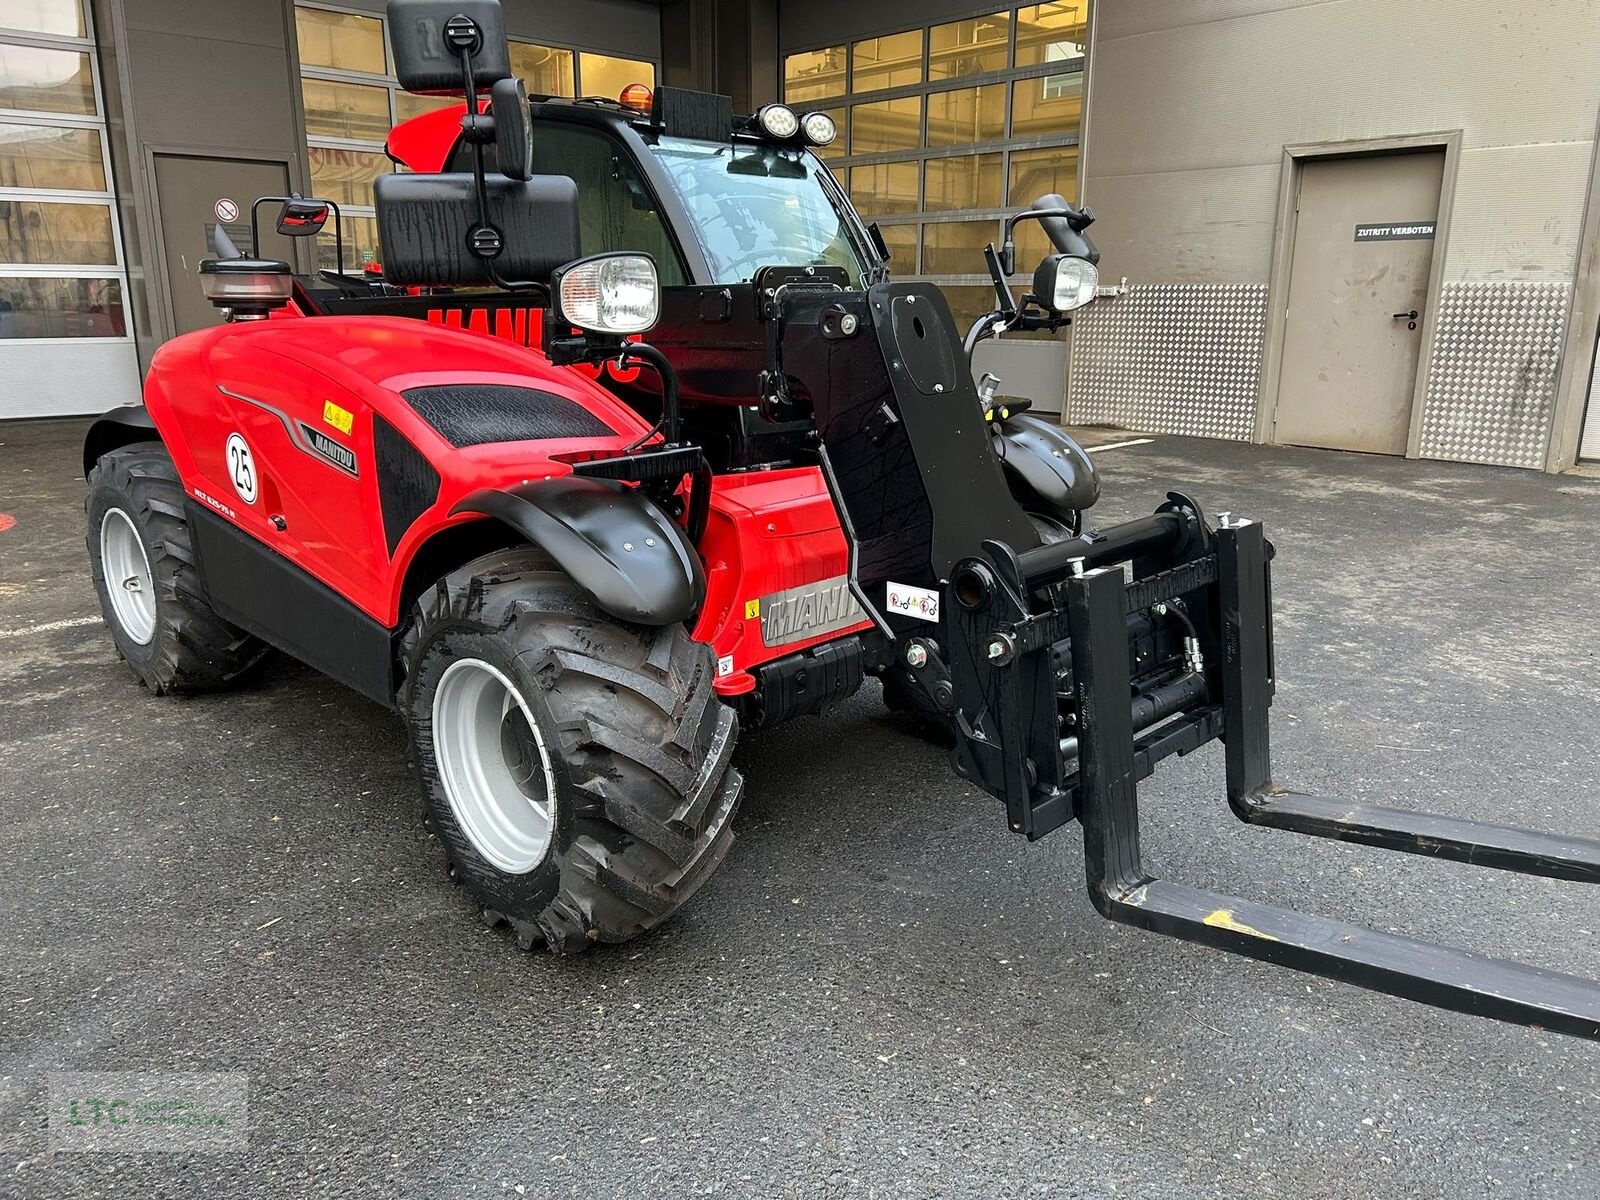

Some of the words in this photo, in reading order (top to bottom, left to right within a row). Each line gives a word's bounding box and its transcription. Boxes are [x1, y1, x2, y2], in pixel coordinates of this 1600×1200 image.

[1357, 228, 1391, 237] ZUTRITT
[1391, 226, 1434, 235] VERBOTEN
[315, 433, 353, 468] MANITOU
[231, 446, 252, 493] 25
